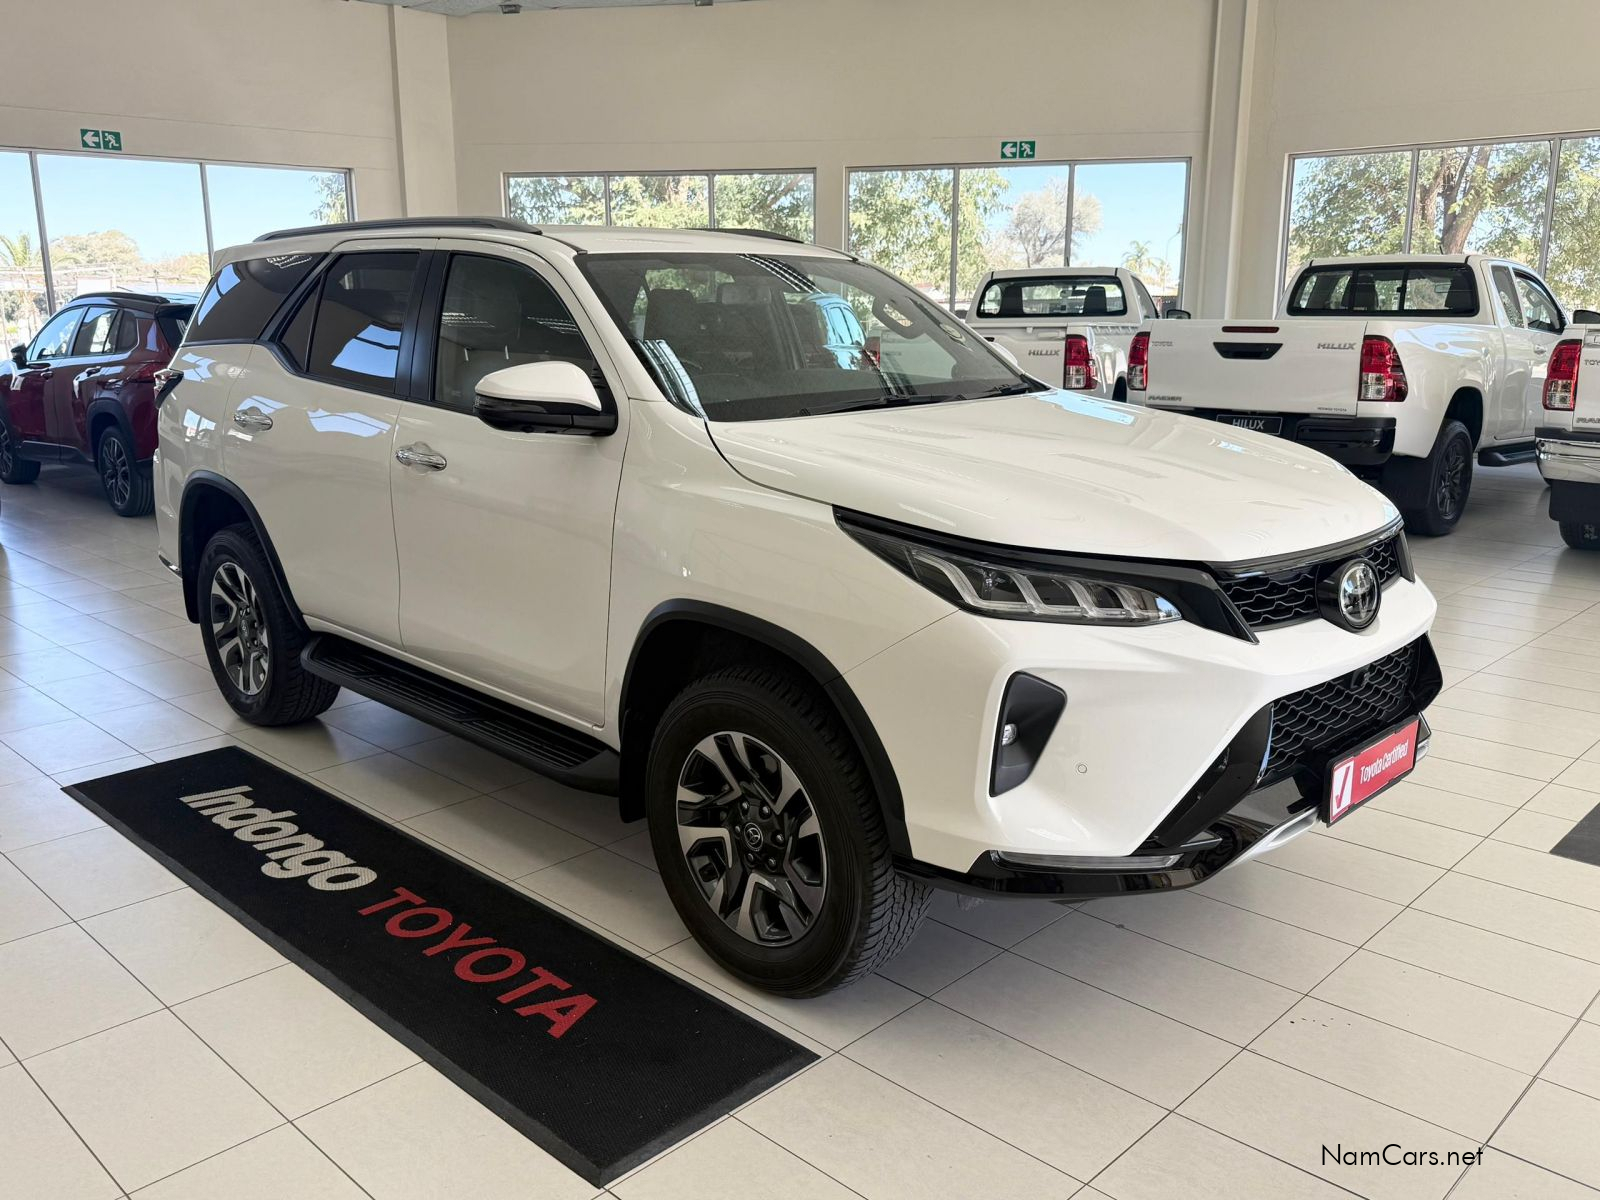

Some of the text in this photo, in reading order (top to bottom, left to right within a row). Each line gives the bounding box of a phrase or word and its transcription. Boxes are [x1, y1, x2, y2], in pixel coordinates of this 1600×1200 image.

[1317, 341, 1357, 351] HILUX
[1028, 349, 1061, 357] HILUX
[1232, 418, 1265, 431] HILUX
[1360, 739, 1409, 785] Toyota Certified
[178, 785, 598, 1039] Indongo TOYOTA
